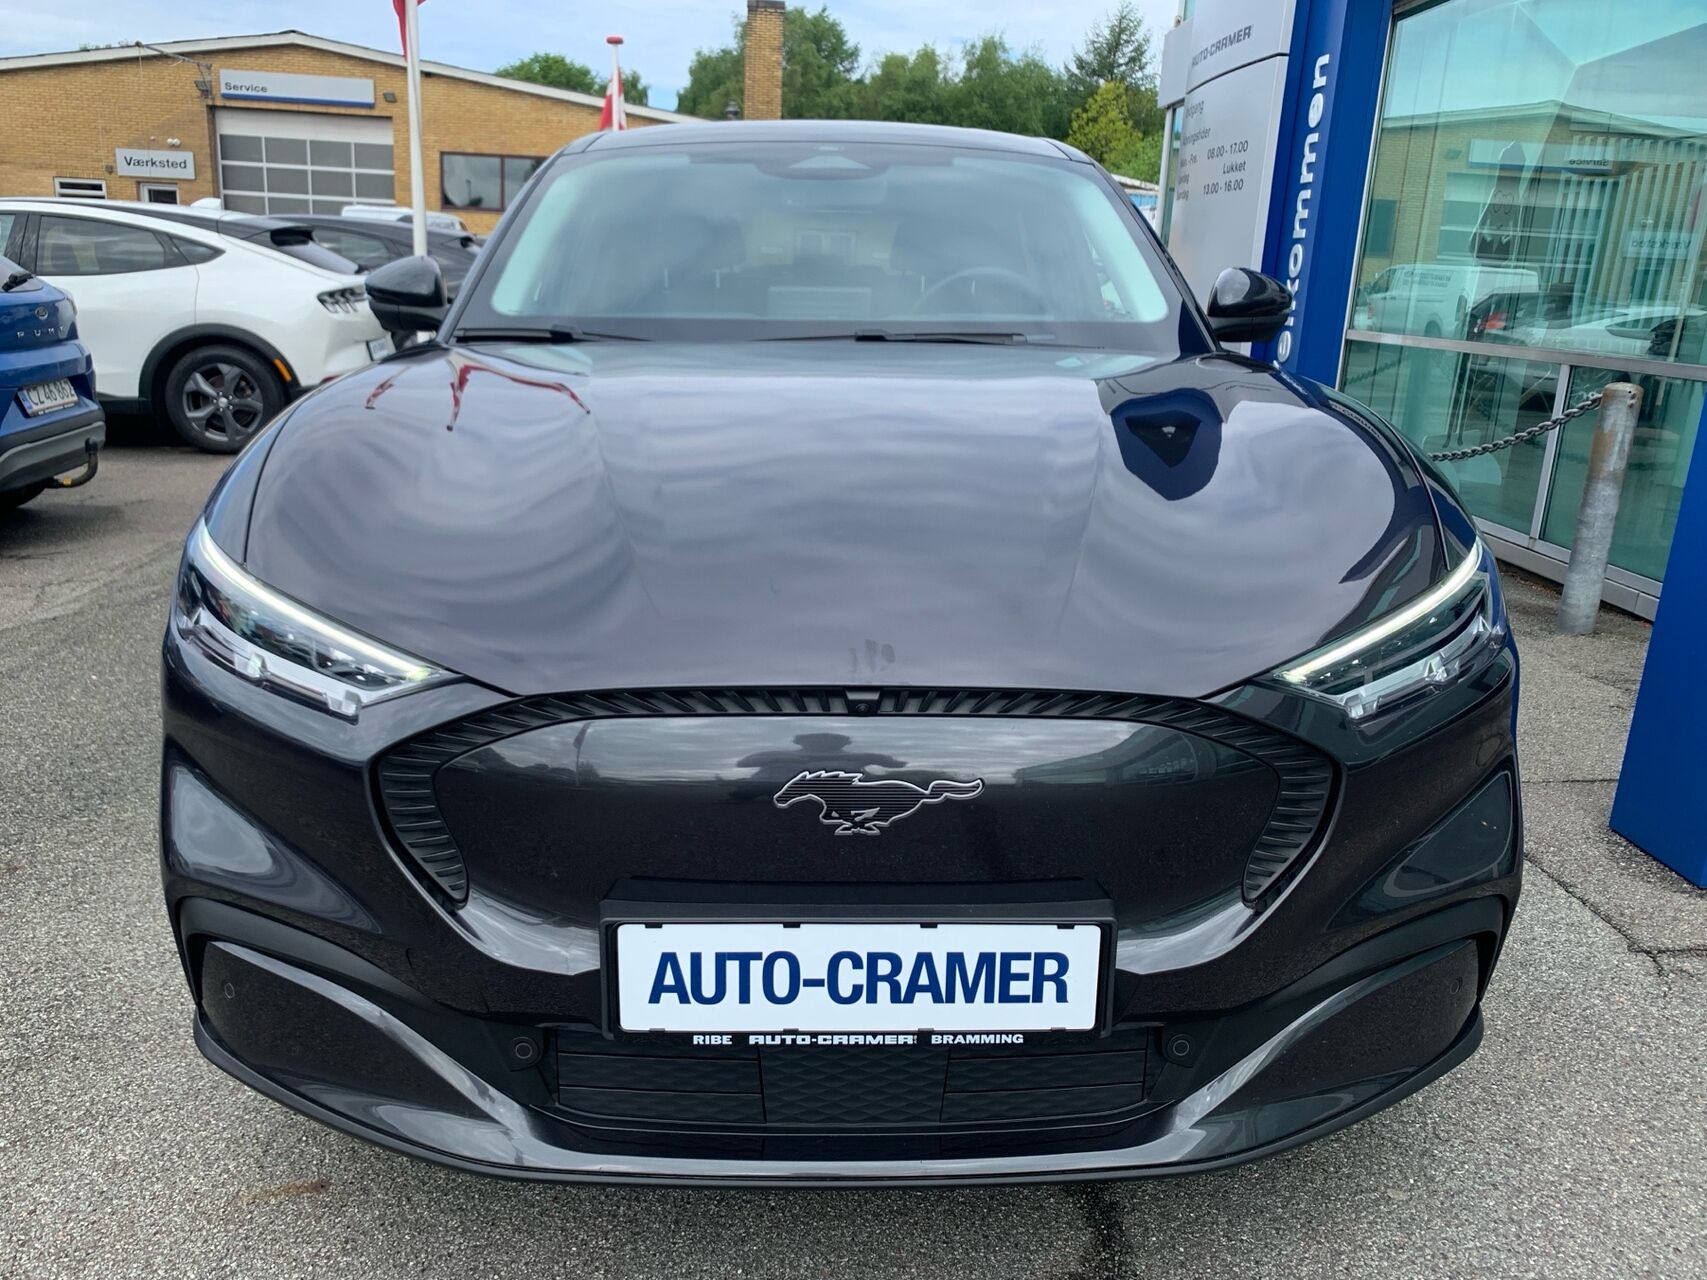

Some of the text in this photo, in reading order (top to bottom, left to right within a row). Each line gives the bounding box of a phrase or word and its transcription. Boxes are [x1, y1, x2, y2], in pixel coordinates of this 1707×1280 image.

[1191, 25, 1252, 66] AUTO-CRAMER
[224, 81, 268, 93] Service
[1230, 140, 1249, 155] 17.00
[124, 155, 187, 170] Værksted
[1223, 161, 1246, 174] Lukket
[1203, 182, 1219, 196] 13.00
[1224, 179, 1244, 192] 16.00
[1273, 53, 1331, 369] ekommen
[648, 950, 1069, 1005] AUTO-CRAMER
[693, 1035, 733, 1045] RIBE
[931, 1034, 1024, 1044] BRAMMING
